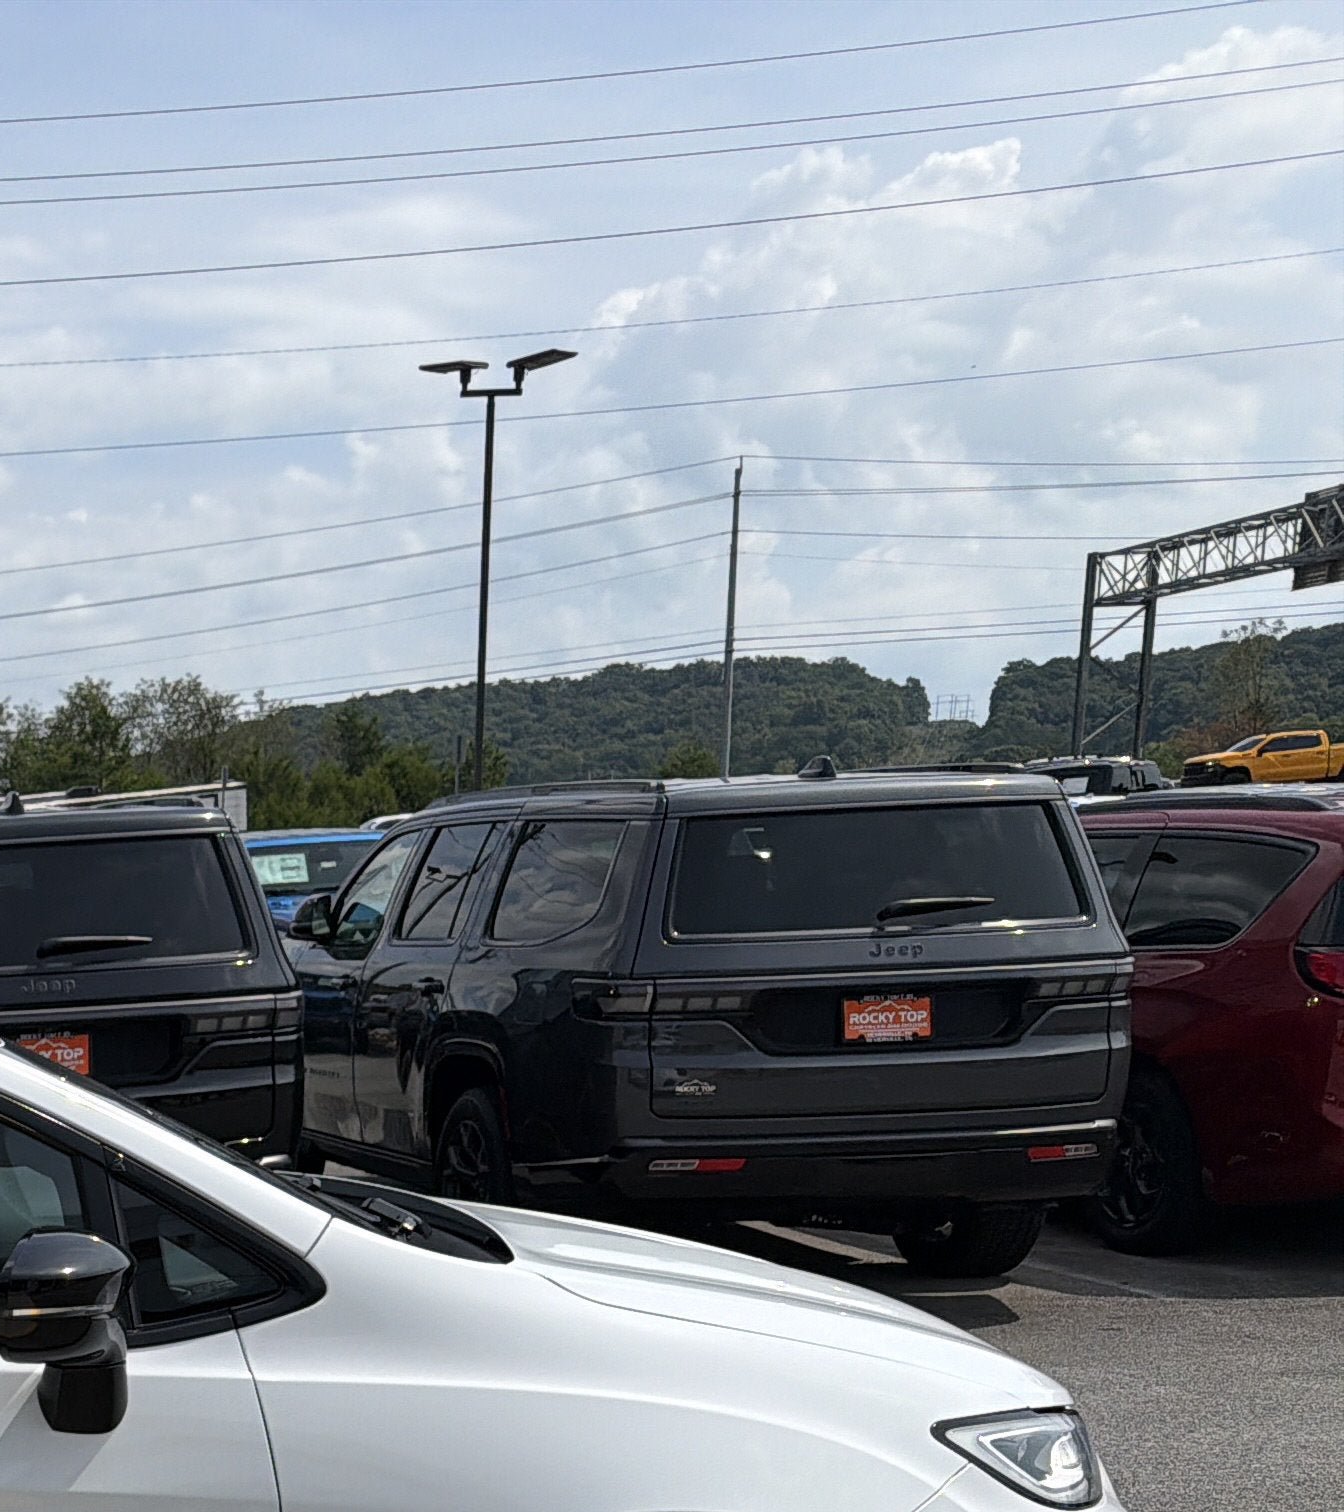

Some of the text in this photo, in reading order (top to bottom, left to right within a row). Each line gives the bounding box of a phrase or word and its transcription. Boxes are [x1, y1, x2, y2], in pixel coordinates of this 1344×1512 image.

[869, 943, 923, 958] Jeep
[21, 978, 76, 993] Jeep
[849, 1011, 927, 1024] ROCKY TOP
[56, 1047, 84, 1061] TOP
